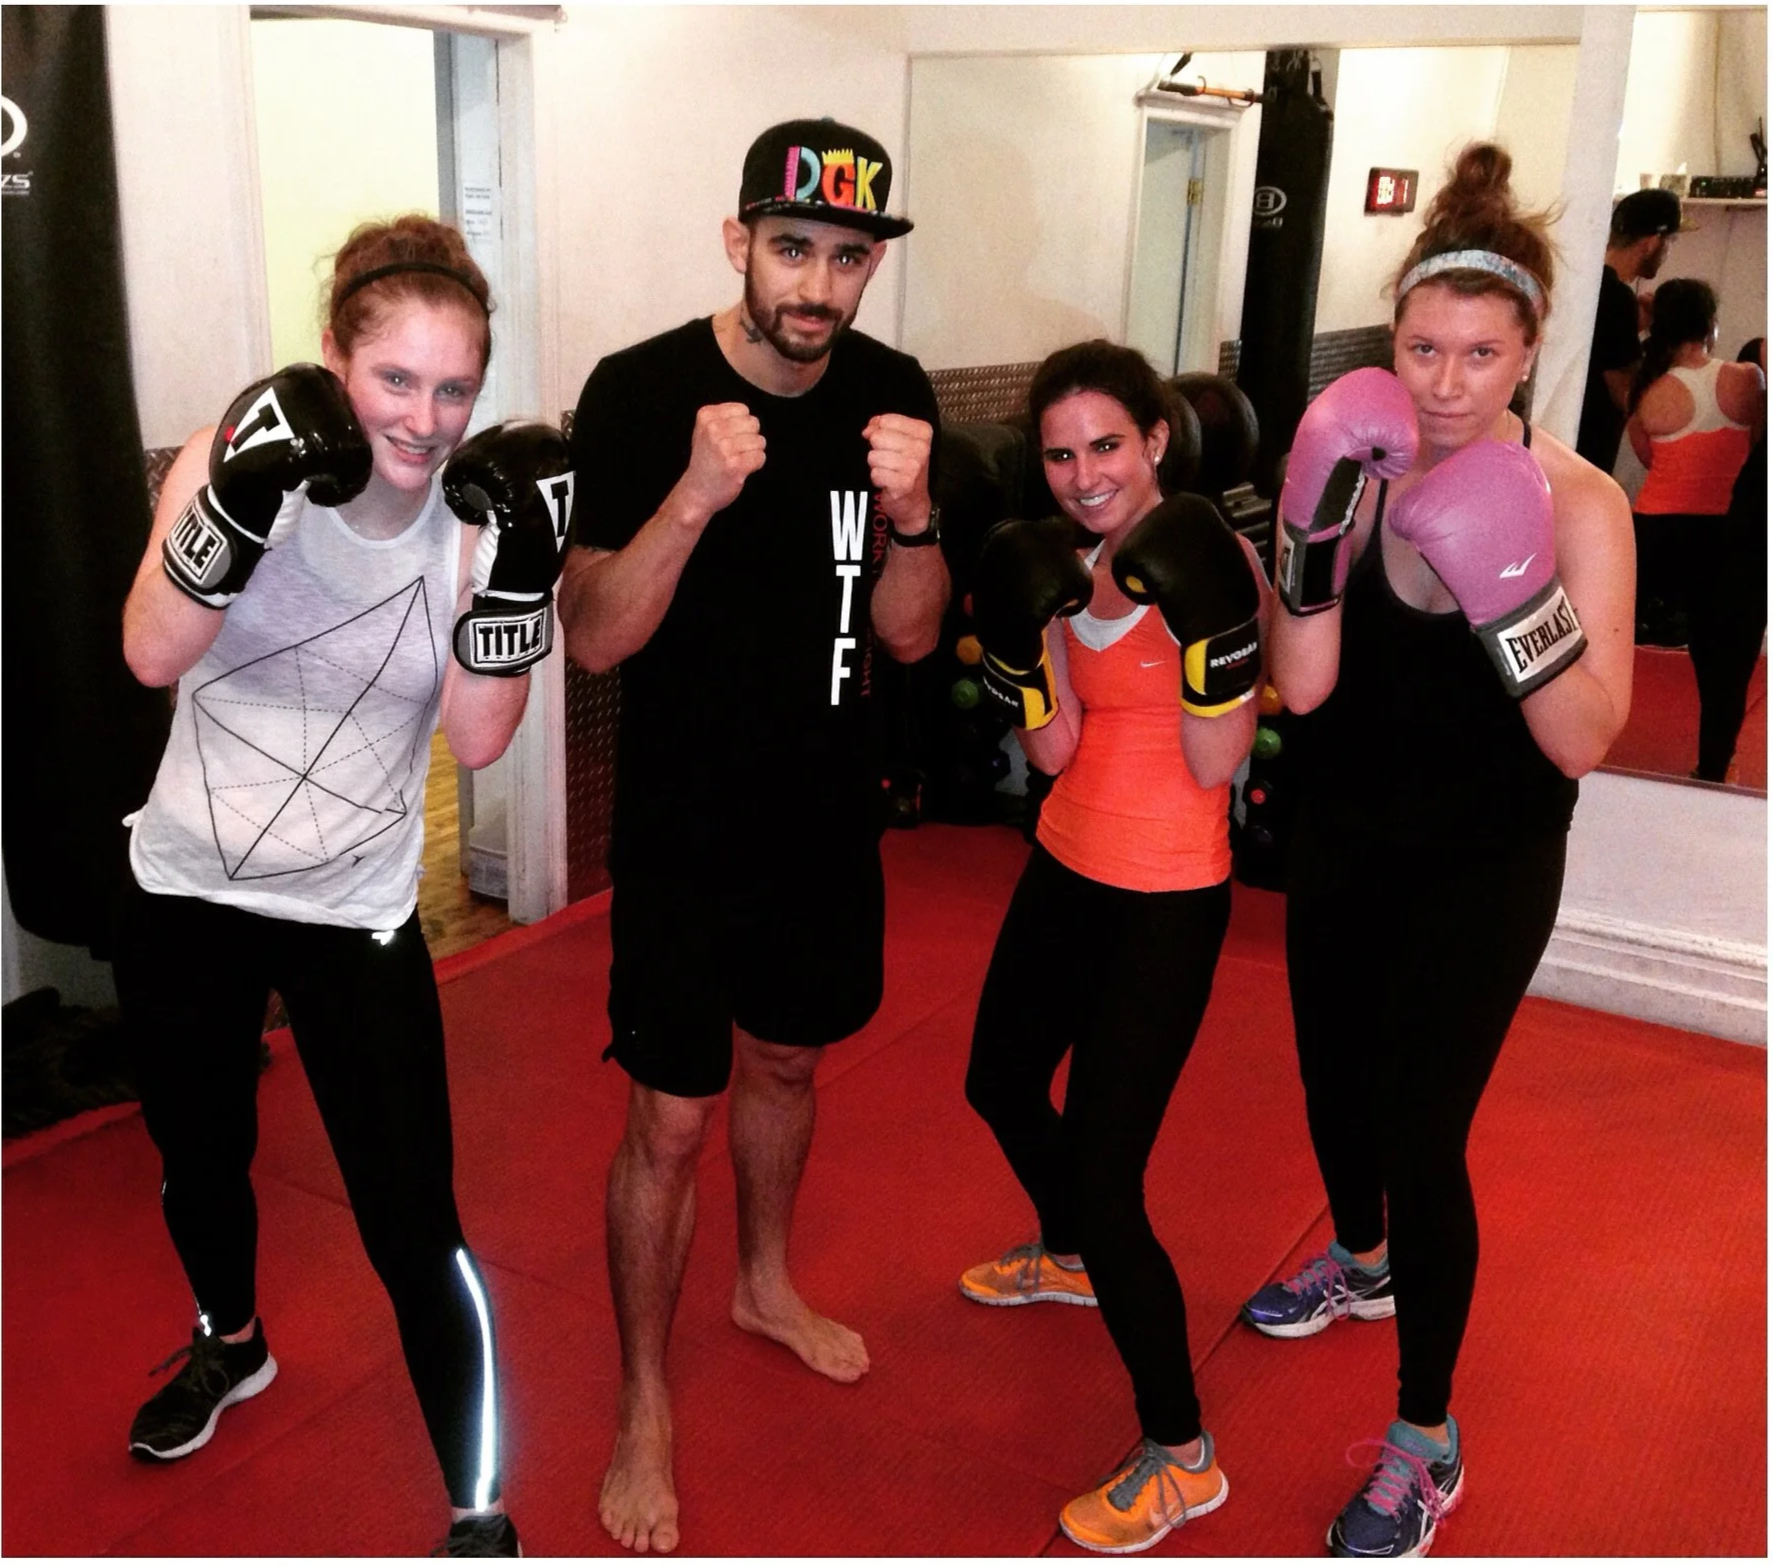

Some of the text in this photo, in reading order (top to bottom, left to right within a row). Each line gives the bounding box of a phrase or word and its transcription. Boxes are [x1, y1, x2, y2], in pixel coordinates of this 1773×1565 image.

[784, 145, 884, 211] DGK
[830, 490, 868, 706] WTF
[1505, 595, 1579, 673] EVERLAST
[478, 617, 541, 657] TITLE
